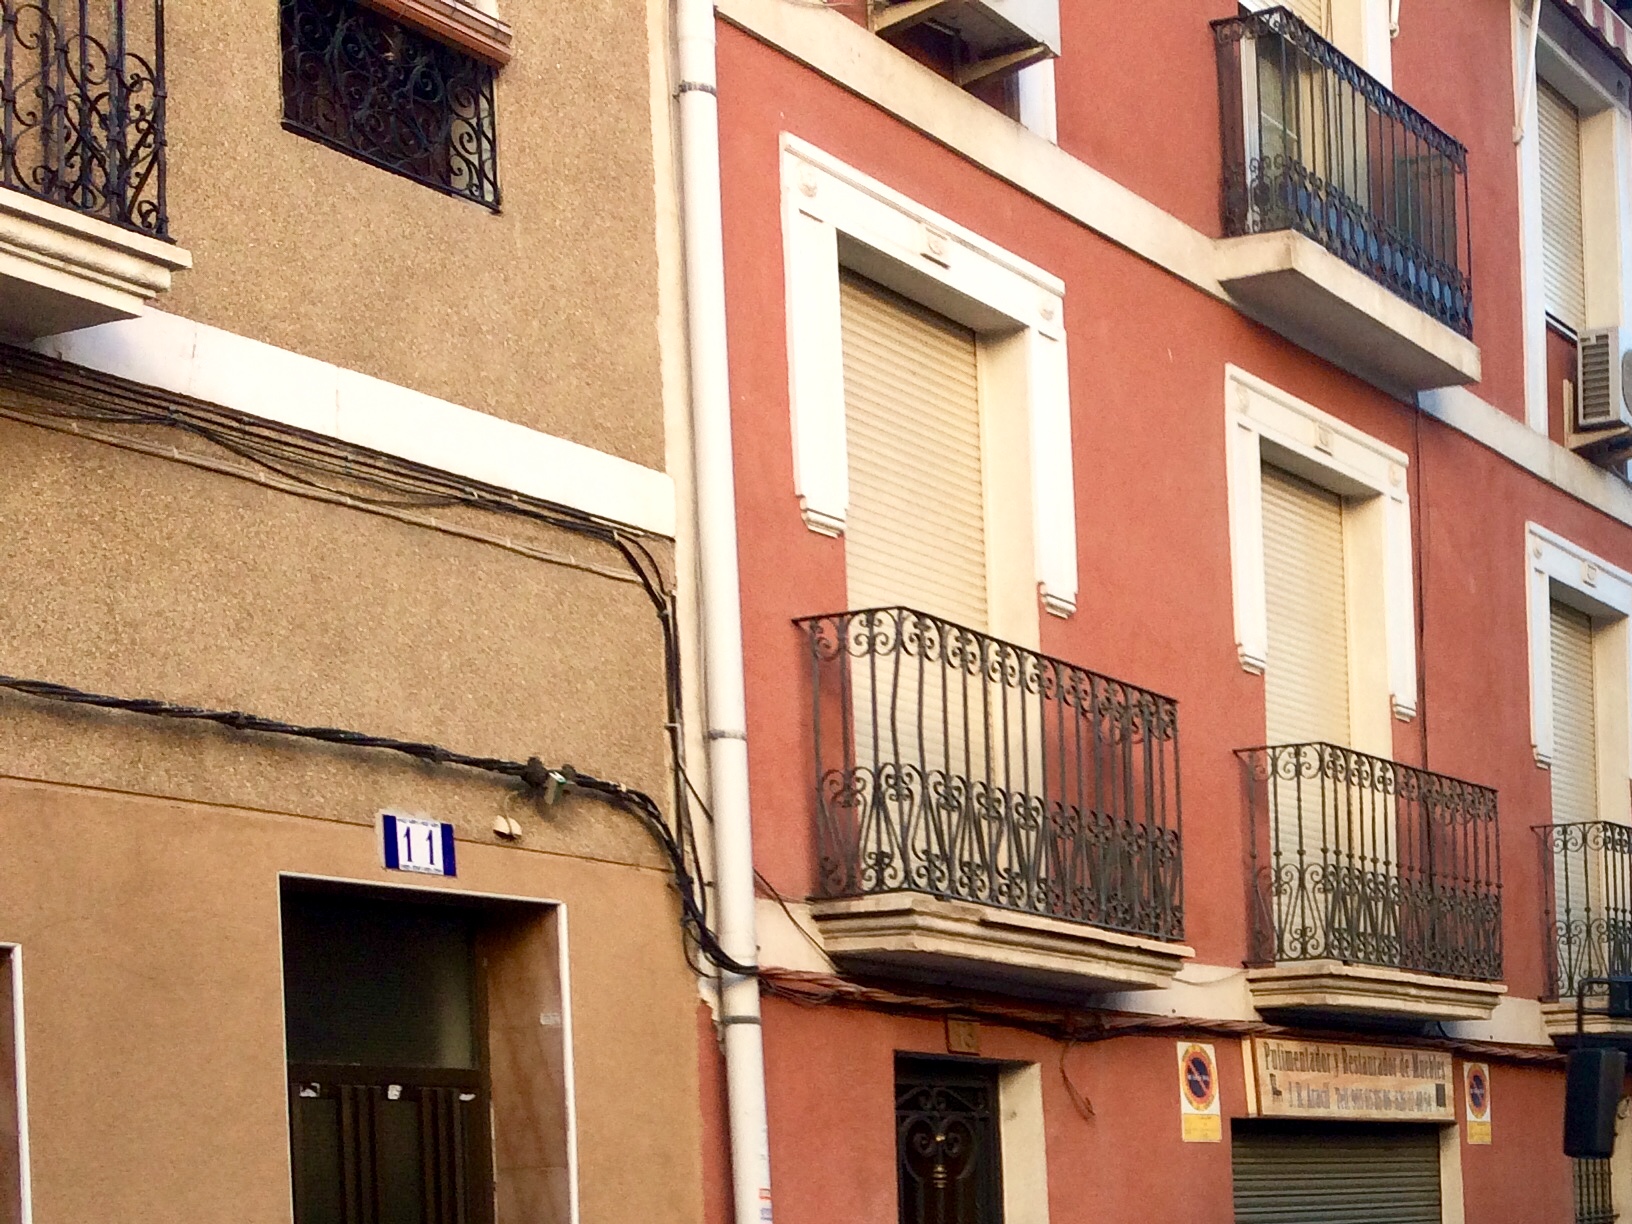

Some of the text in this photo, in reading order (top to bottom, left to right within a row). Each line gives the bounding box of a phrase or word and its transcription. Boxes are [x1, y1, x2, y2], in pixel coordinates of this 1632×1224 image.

[403, 825, 435, 866] 11
[1263, 1041, 1446, 1080] Pulimentador y Restaurador de Muebles
